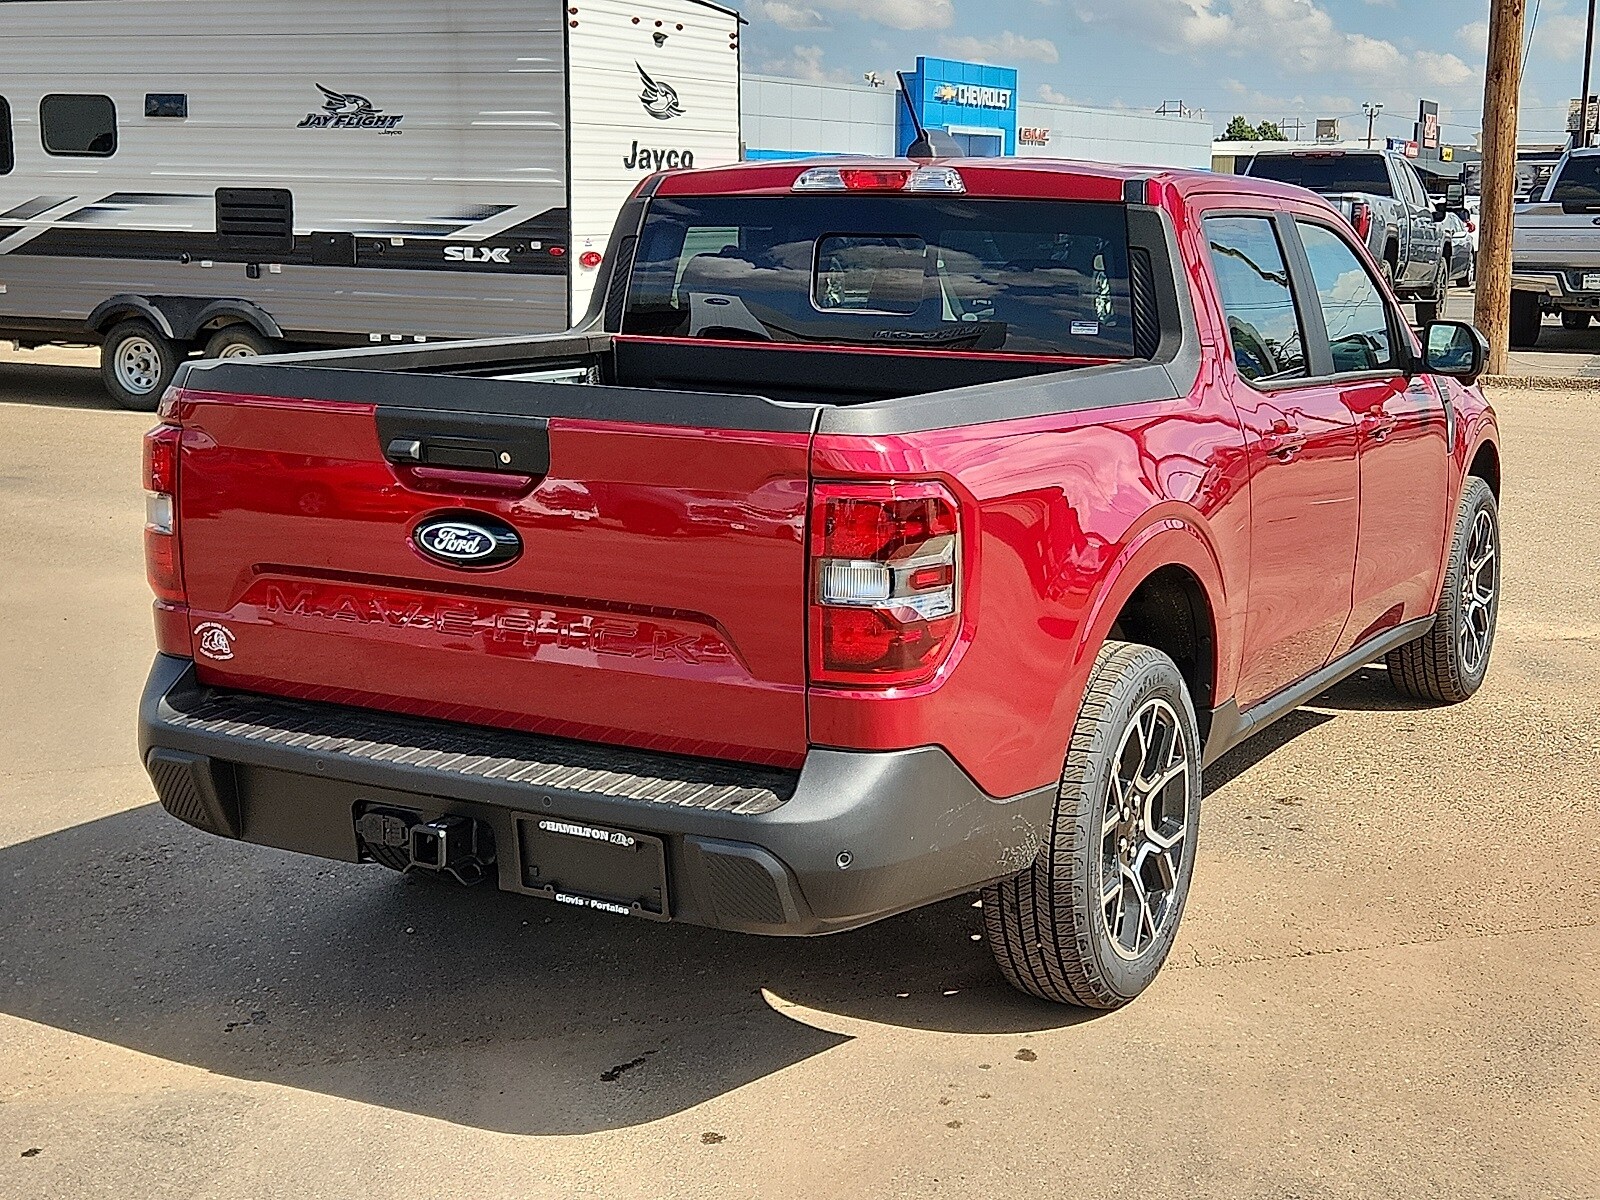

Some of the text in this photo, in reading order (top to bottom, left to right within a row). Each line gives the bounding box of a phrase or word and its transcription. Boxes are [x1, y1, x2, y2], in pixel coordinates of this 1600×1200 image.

[956, 84, 1012, 109] CHEVROLET
[297, 113, 404, 128] JAY FLIGHT
[623, 140, 694, 172] Jayco
[443, 246, 511, 264] SLX
[433, 527, 481, 554] Ford
[265, 584, 704, 665] MAVERICK
[546, 821, 609, 841] HAMILTON
[556, 894, 630, 915] Clovis Portales
